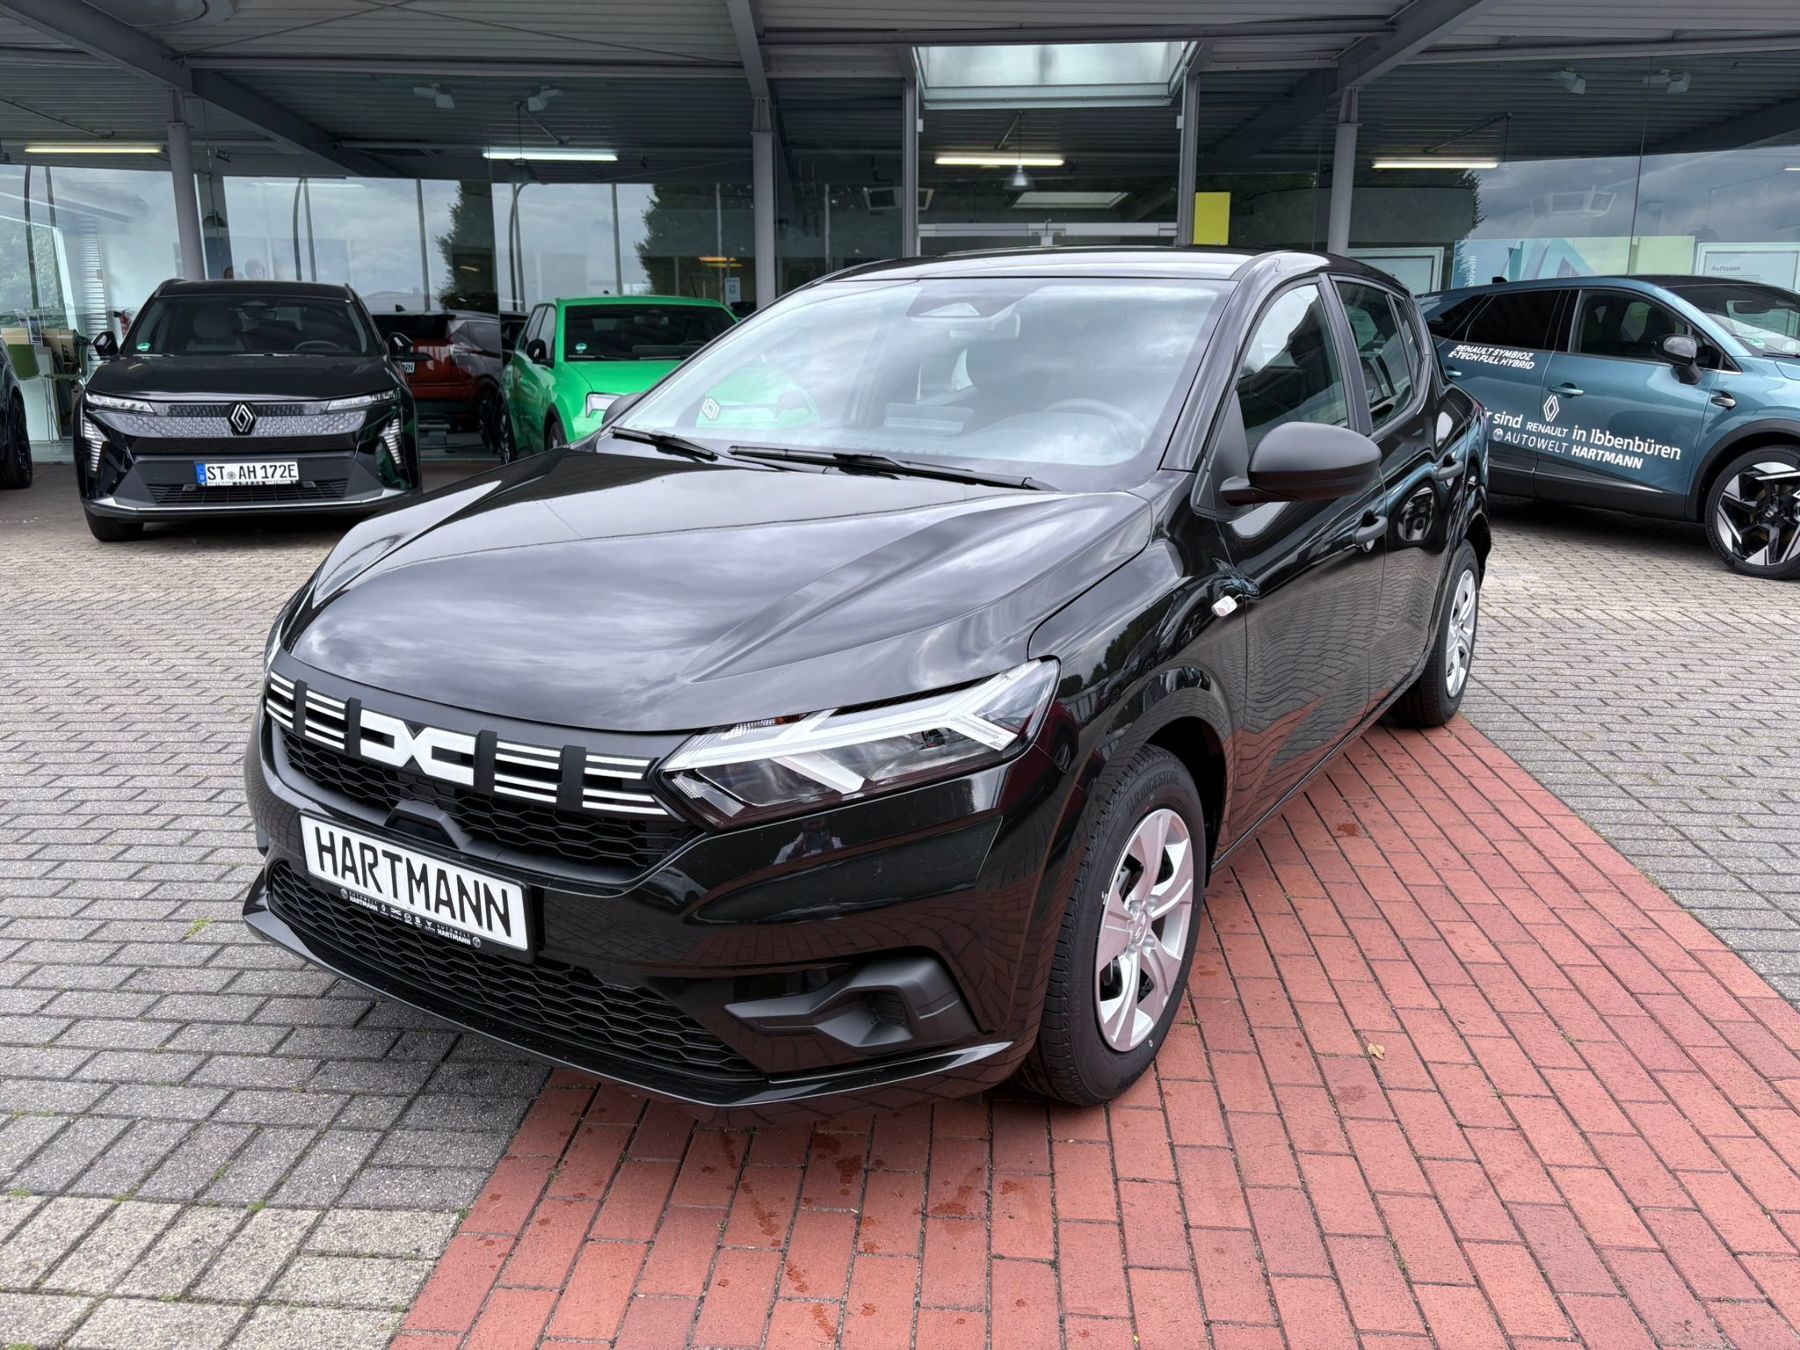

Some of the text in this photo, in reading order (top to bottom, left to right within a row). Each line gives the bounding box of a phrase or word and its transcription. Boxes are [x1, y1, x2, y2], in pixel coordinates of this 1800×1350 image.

[1447, 350, 1536, 370] E-TECH FULL HYBRID
[1454, 344, 1534, 361] RENAULT SYMBIOZ
[1493, 410, 1524, 429] sind
[1526, 421, 1569, 438] RENAULT
[1572, 424, 1587, 442] in
[1590, 427, 1682, 461] Ibbenbüren
[1504, 431, 1644, 470] AUTOWELT HARTMANN
[207, 463, 297, 481] ST AH 172E
[314, 825, 513, 938] HARTMANN
